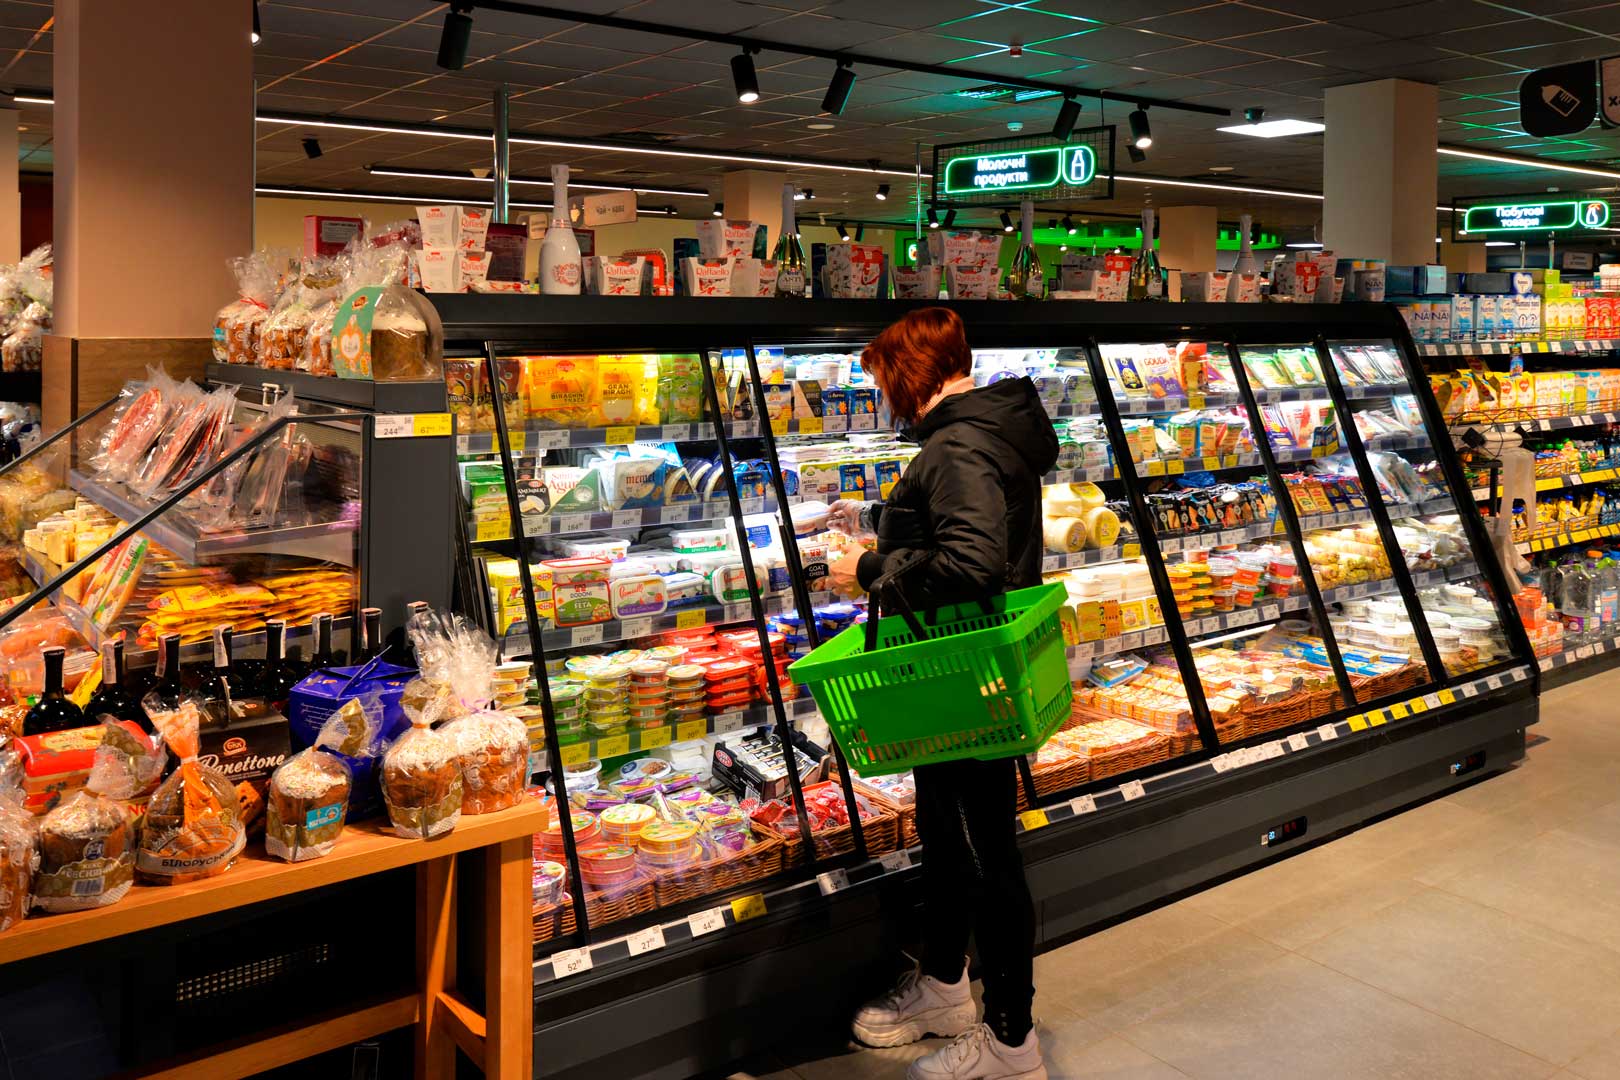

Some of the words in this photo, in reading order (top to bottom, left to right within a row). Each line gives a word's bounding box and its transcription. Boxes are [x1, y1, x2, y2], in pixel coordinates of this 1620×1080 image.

[977, 155, 1026, 171] Молочні
[974, 171, 1029, 188] продукти
[1496, 206, 1545, 218] Побутові
[1501, 218, 1539, 229] товари
[606, 264, 640, 277] Raffaello
[696, 266, 729, 277] Raffaello
[199, 753, 286, 776] Panettone
